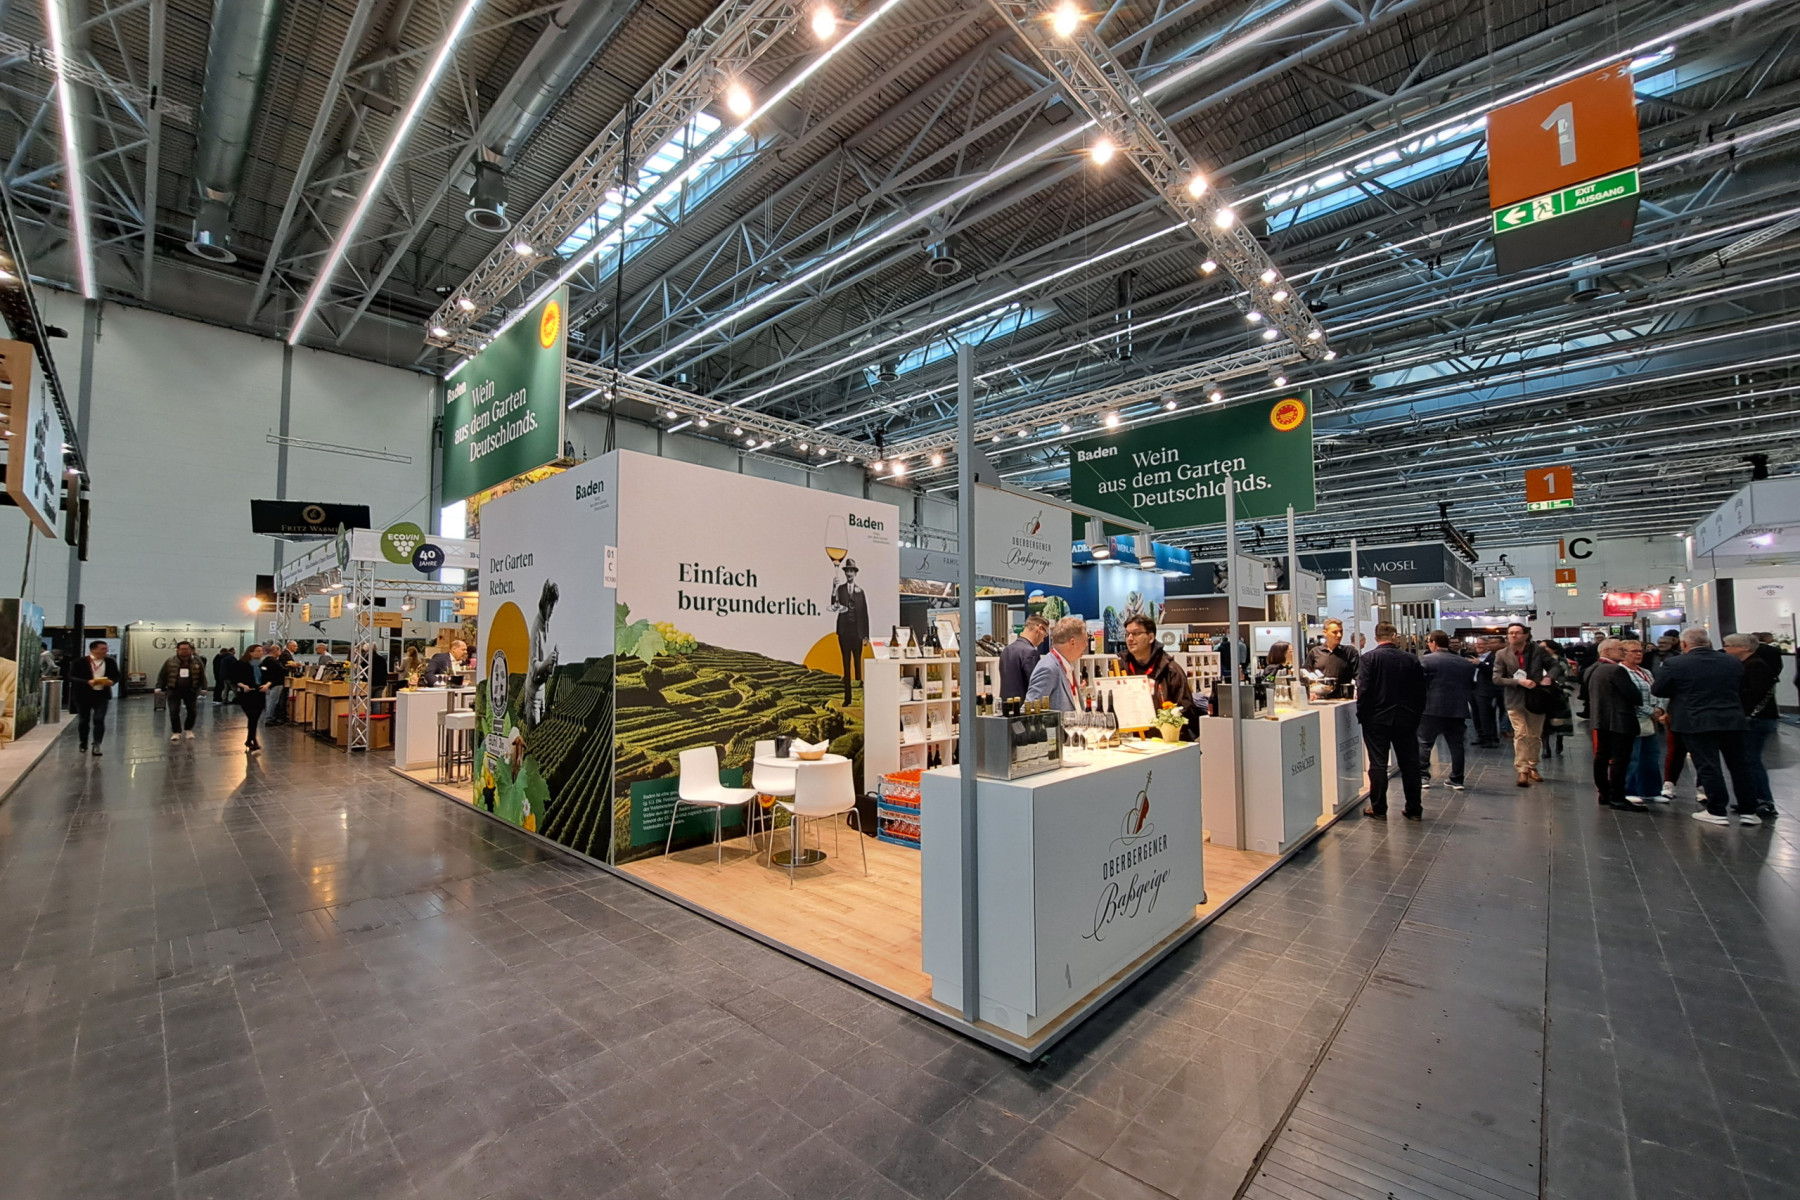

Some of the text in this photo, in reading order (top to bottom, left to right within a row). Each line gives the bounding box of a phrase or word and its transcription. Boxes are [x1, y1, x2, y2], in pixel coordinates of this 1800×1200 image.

[1540, 101, 1577, 167] 1
[1574, 184, 1596, 197] EXIT
[1575, 186, 1625, 207] AUSGANG
[447, 381, 467, 405] Baden
[471, 379, 495, 409] Wein
[454, 388, 527, 446] aus dem Garten
[469, 409, 538, 463] Deutschlands.
[1077, 446, 1118, 462] Baden
[1132, 448, 1179, 469] Wein
[1098, 457, 1247, 495] aus dem Garten
[1543, 472, 1556, 494] 1
[575, 480, 604, 501] Baden
[849, 513, 884, 531] Baden
[387, 533, 420, 542] ECOVIN
[1012, 536, 1052, 553] OBERBERGENER
[1568, 537, 1593, 559] C
[418, 560, 438, 568] JAHRE
[419, 550, 436, 561] 40
[490, 552, 534, 574] Der Garten
[1373, 559, 1418, 572] MOSEL
[678, 562, 758, 588] Einfach
[1562, 571, 1570, 581] 1
[489, 578, 515, 596] Reben.
[678, 590, 821, 617] burgunderlich.
[1103, 834, 1168, 881] OBERBERGENER
